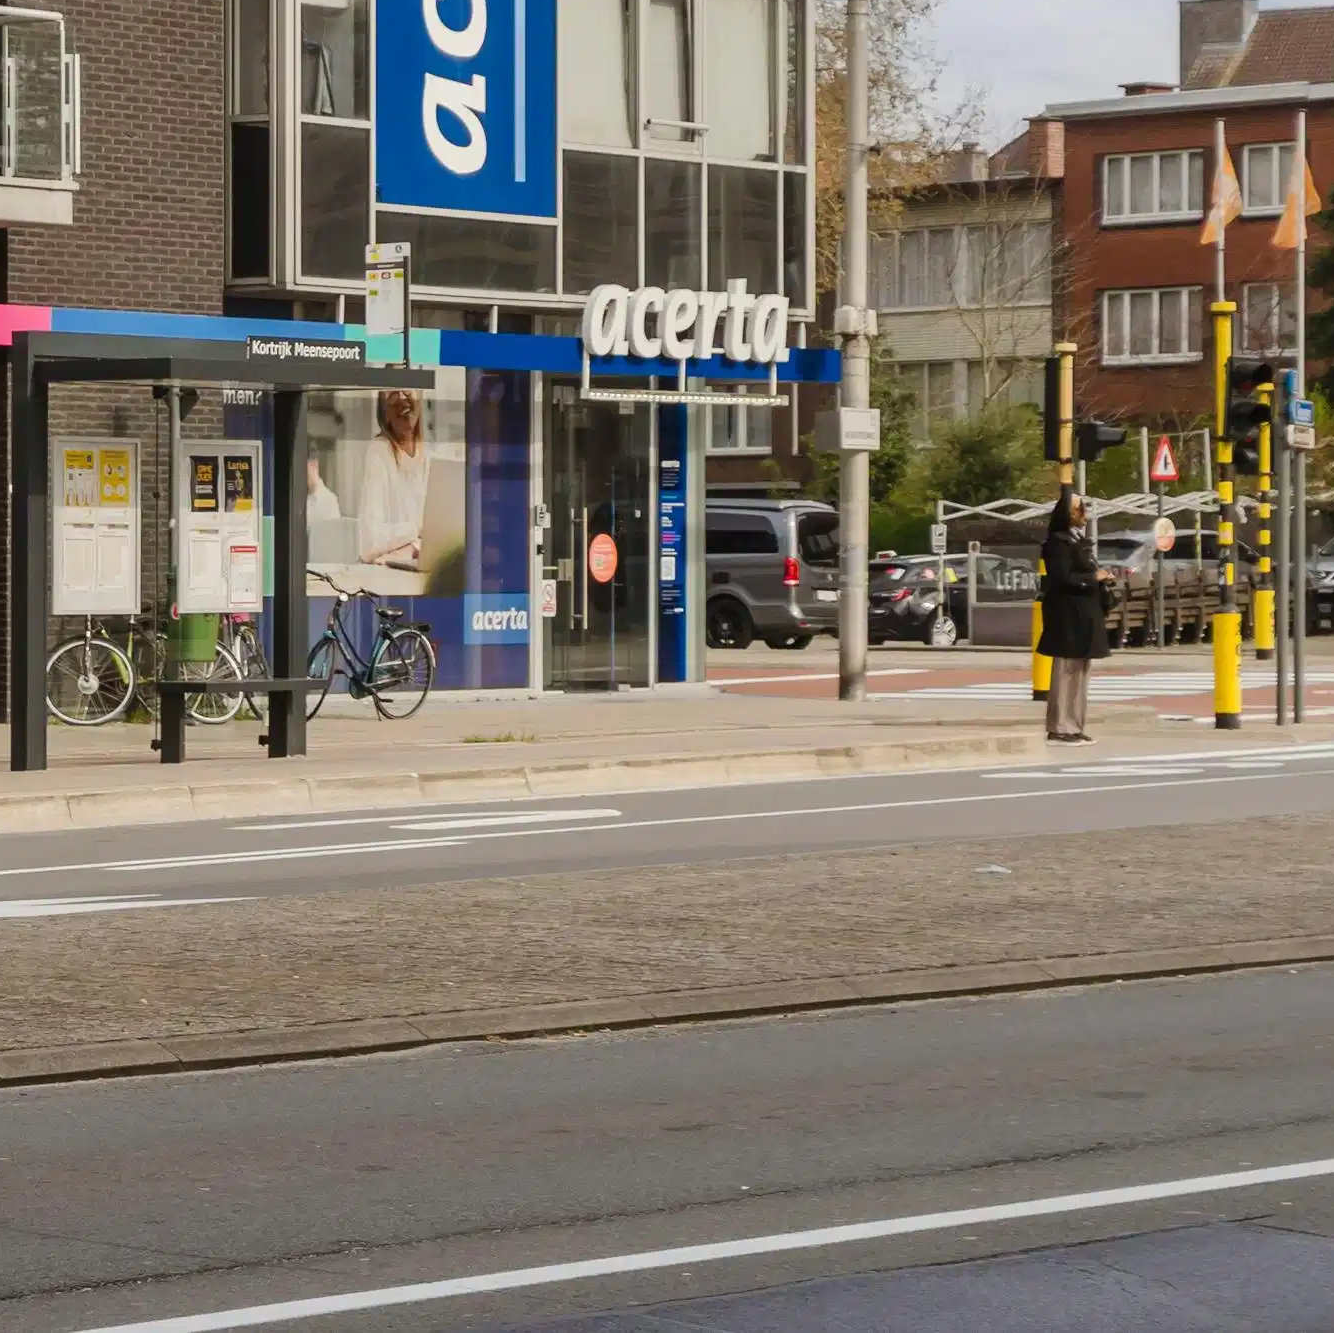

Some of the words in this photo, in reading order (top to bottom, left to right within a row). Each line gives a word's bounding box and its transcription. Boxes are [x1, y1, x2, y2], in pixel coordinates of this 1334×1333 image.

[584, 278, 789, 363] acerta
[252, 340, 292, 359] Kortrijk
[294, 342, 361, 362] Meensepoort
[473, 607, 528, 631] acerta
